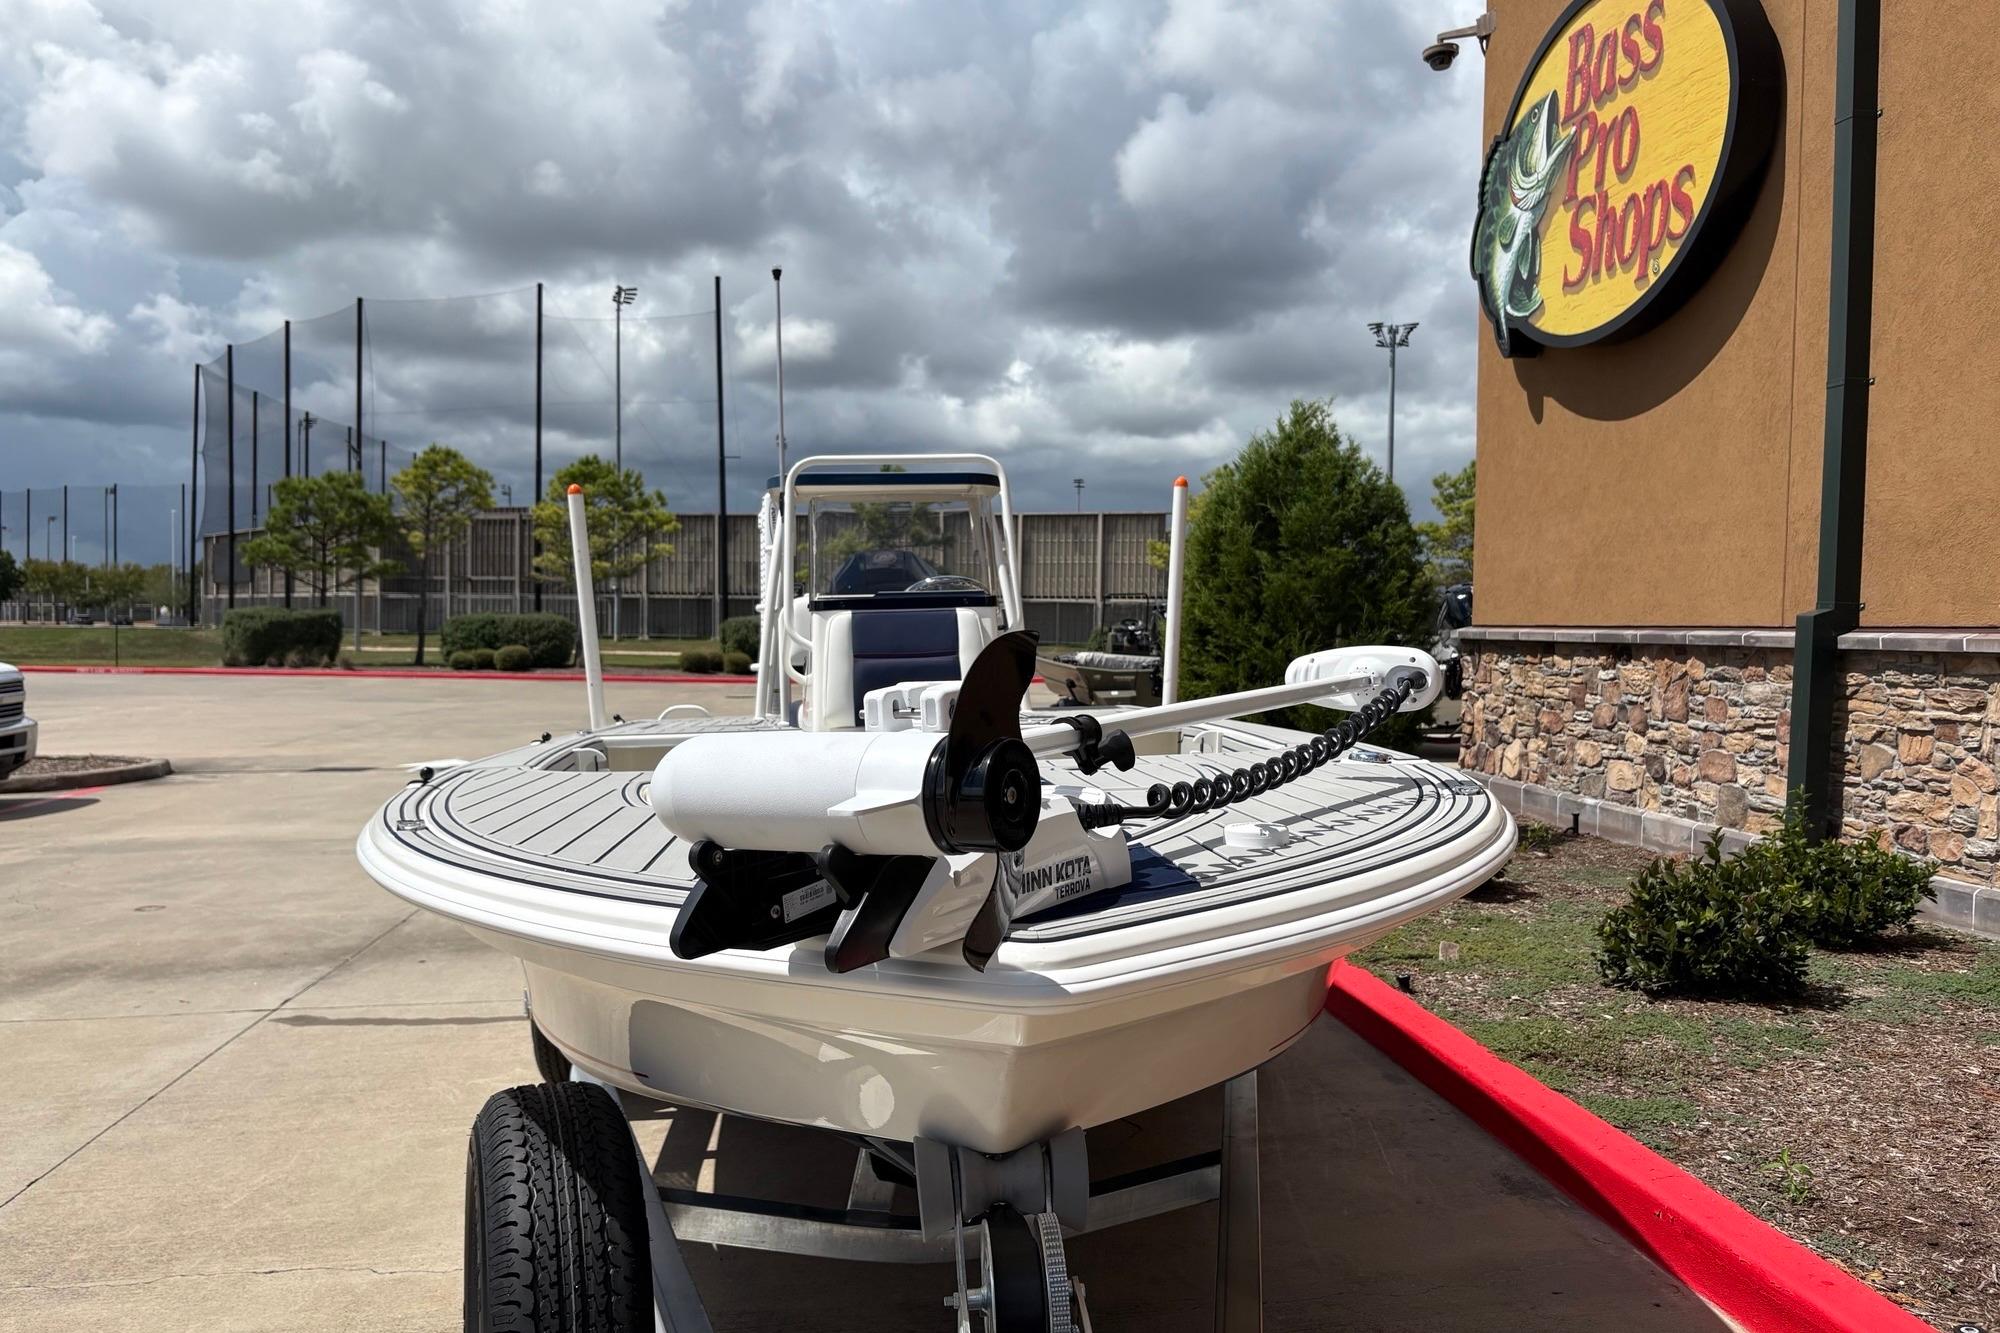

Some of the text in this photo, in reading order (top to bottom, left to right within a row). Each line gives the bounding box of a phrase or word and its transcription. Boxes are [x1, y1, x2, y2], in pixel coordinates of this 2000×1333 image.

[1562, 0, 1664, 123] Bass
[1563, 106, 1640, 204] Pro
[1562, 164, 1695, 288] Shops
[1055, 878, 1091, 900] TERROVA
[1056, 856, 1092, 883] KOTA
